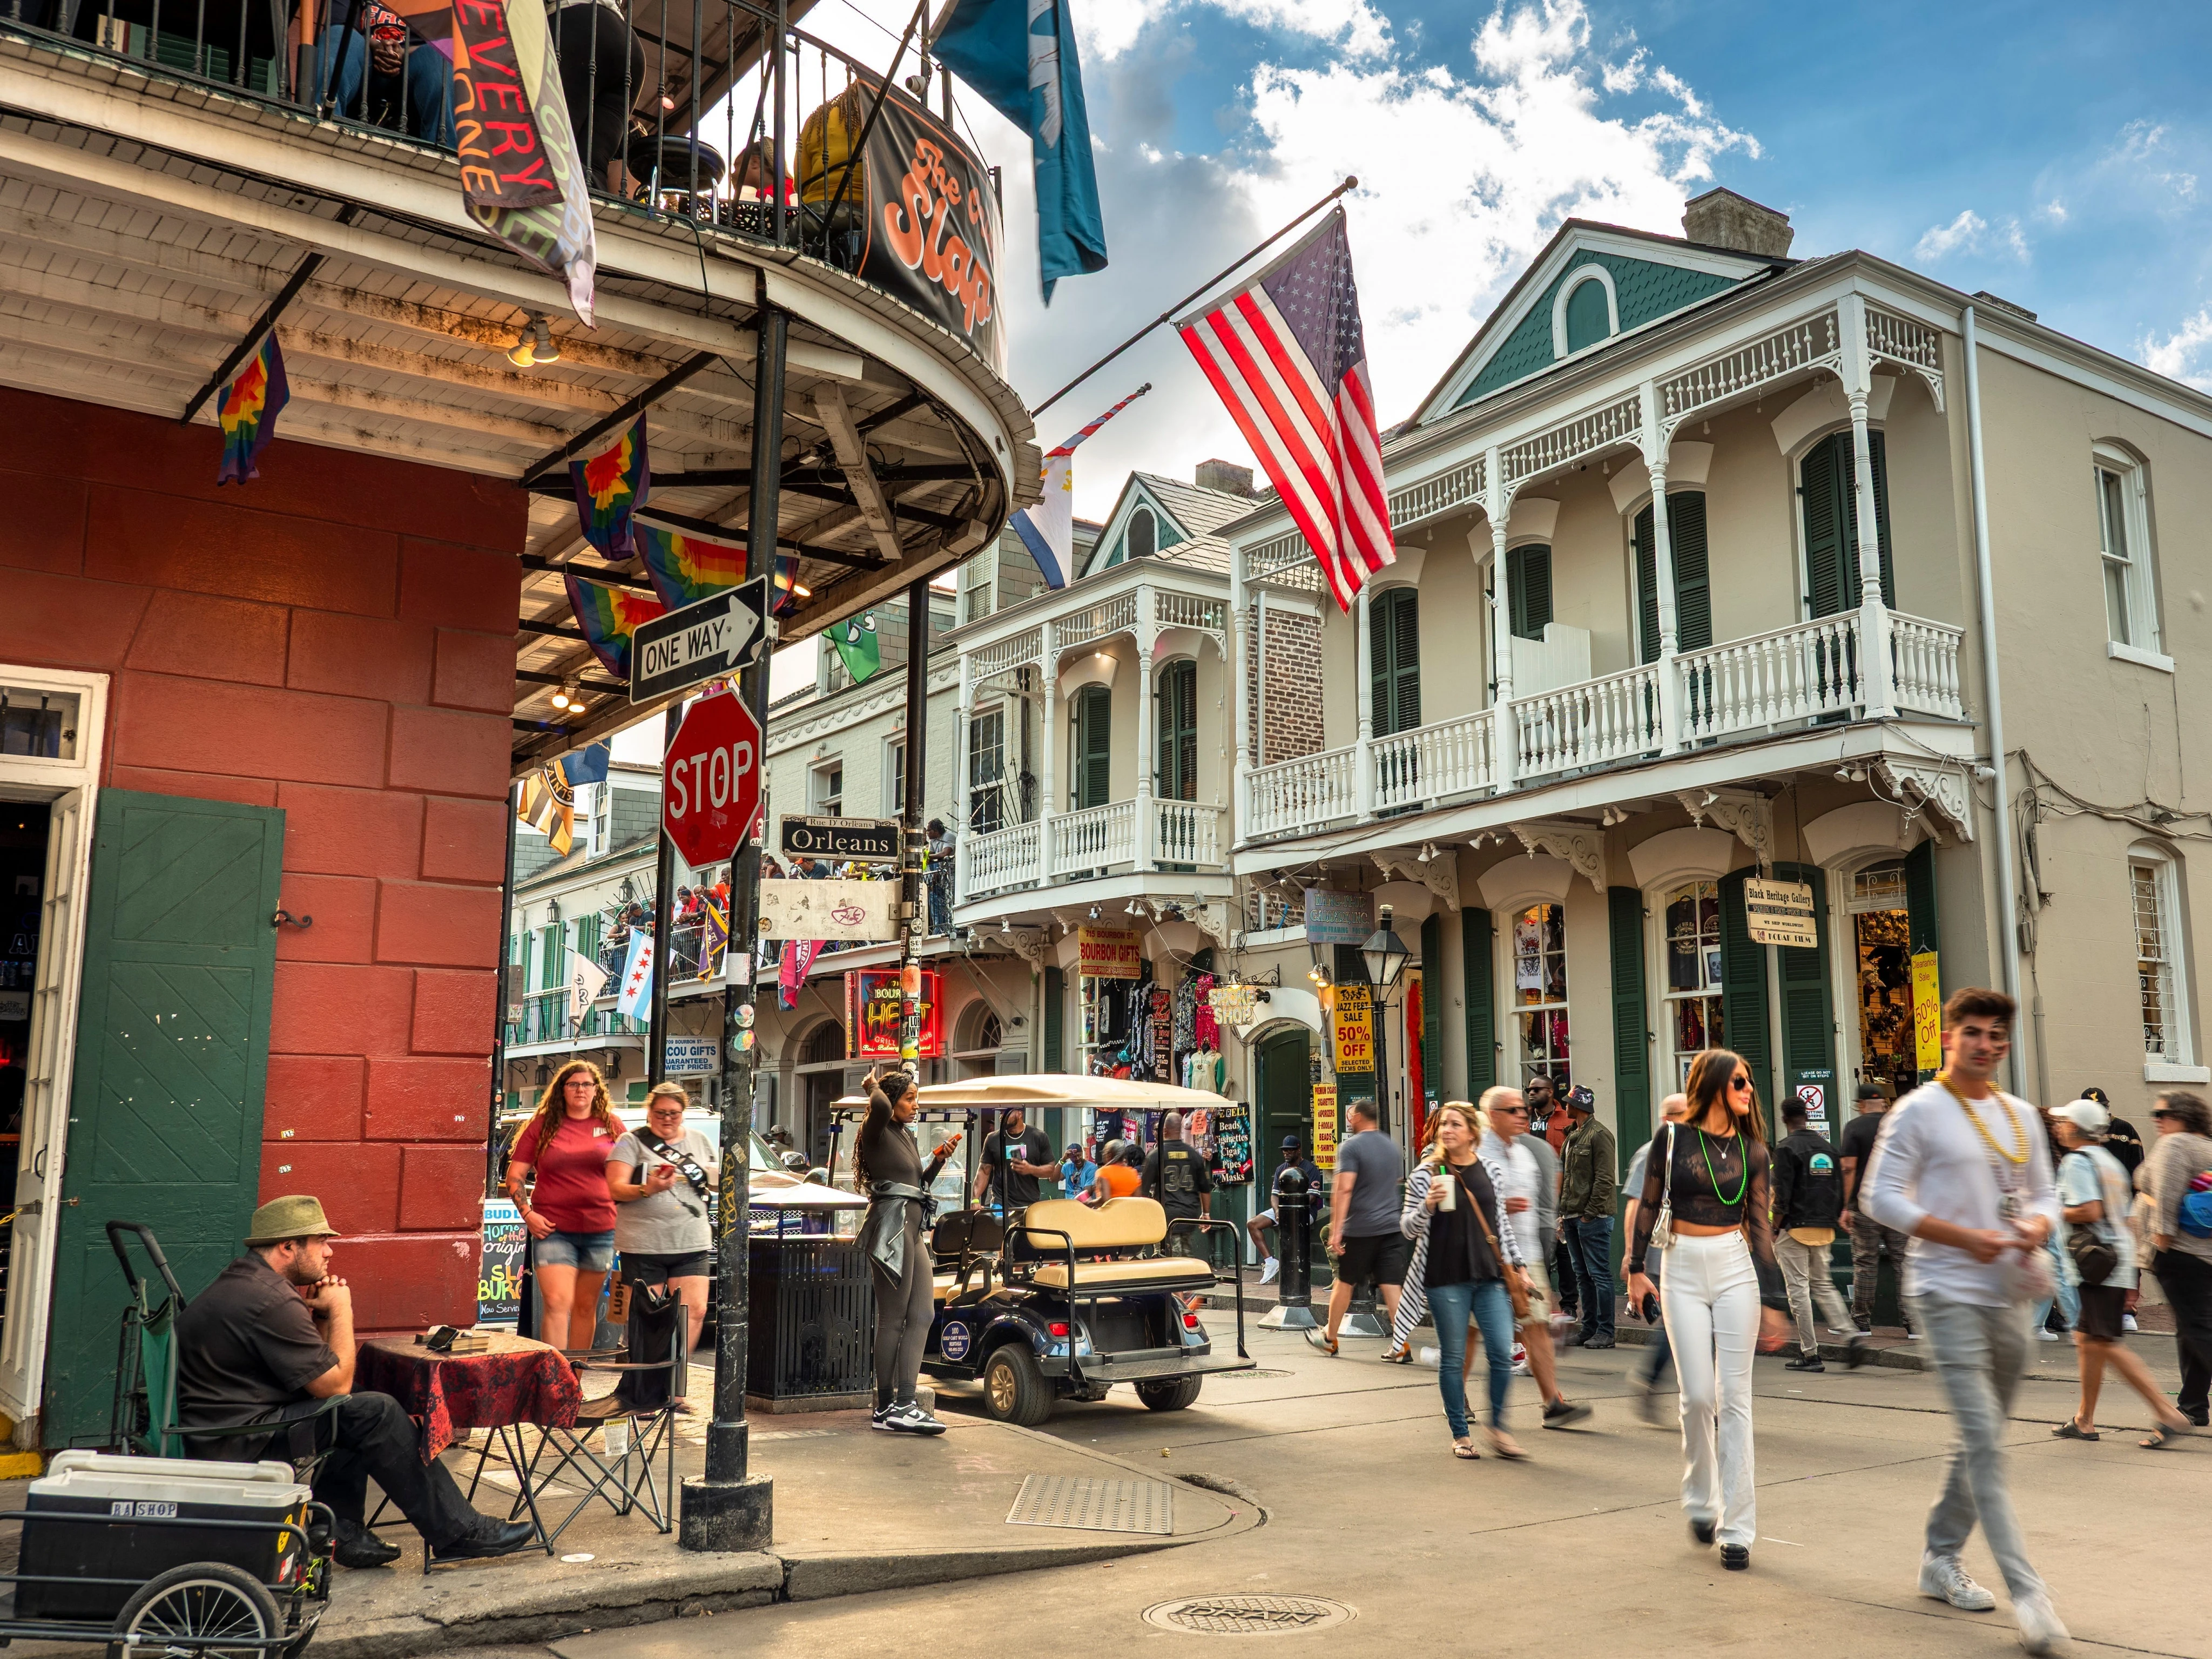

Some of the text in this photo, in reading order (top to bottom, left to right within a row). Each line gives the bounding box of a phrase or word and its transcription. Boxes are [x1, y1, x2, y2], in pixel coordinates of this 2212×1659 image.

[455, 0, 554, 190] EVERY
[912, 138, 961, 205] The
[885, 172, 993, 337] Slap
[646, 618, 726, 675] ONE WAY
[546, 761, 573, 801] SAINTS
[670, 740, 753, 819] STOP
[792, 829, 889, 852] Orleans
[1314, 893, 1367, 908] HANG-IT-UP
[1748, 888, 1811, 907] Black Heritage Gallery
[1310, 909, 1370, 925] GALLERY, INC.
[1097, 930, 1125, 939] BOURBON
[1768, 933, 1811, 943] KODAK FILM
[1080, 942, 1139, 962] BOURBON GIFTS
[1912, 959, 1937, 969] Clearance
[1918, 973, 1930, 982] Sale
[874, 988, 901, 999] BOUR
[1209, 989, 1256, 1006] SMOKE
[1336, 1001, 1368, 1012] JAZZ FEST
[1916, 995, 1938, 1024] 50%
[867, 1002, 932, 1037] HET
[1215, 1007, 1252, 1025] SHOP
[1344, 1012, 1363, 1022] SALE
[874, 1031, 933, 1047] GRILL LUB
[1338, 1026, 1370, 1042] 50%
[1921, 1019, 1937, 1044] Off
[690, 1046, 716, 1056] GIFTS
[1343, 1043, 1366, 1057] OFF
[1314, 1085, 1337, 1095] PREMIUM CIGARS
[1317, 1097, 1334, 1106] CIGARETTES
[1318, 1109, 1335, 1117] VAPORIZERS
[1219, 1121, 1240, 1131] Beads
[1318, 1122, 1334, 1130] E-HOOKAH
[1319, 1132, 1332, 1141] BEADS
[1220, 1147, 1241, 1157] Cigar
[1316, 1155, 1336, 1163] COLD DRINKS
[1222, 1160, 1242, 1171] Pipes
[1164, 1165, 1194, 1192] 34
[1221, 1172, 1245, 1182] Masks
[484, 1209, 512, 1219] BUD
[498, 1228, 526, 1242] of the
[483, 1240, 526, 1266] origin
[491, 1264, 523, 1282] SLA
[477, 1279, 523, 1300] BURG
[613, 1280, 625, 1316] LUSH
[481, 1303, 520, 1314] Now Servin
